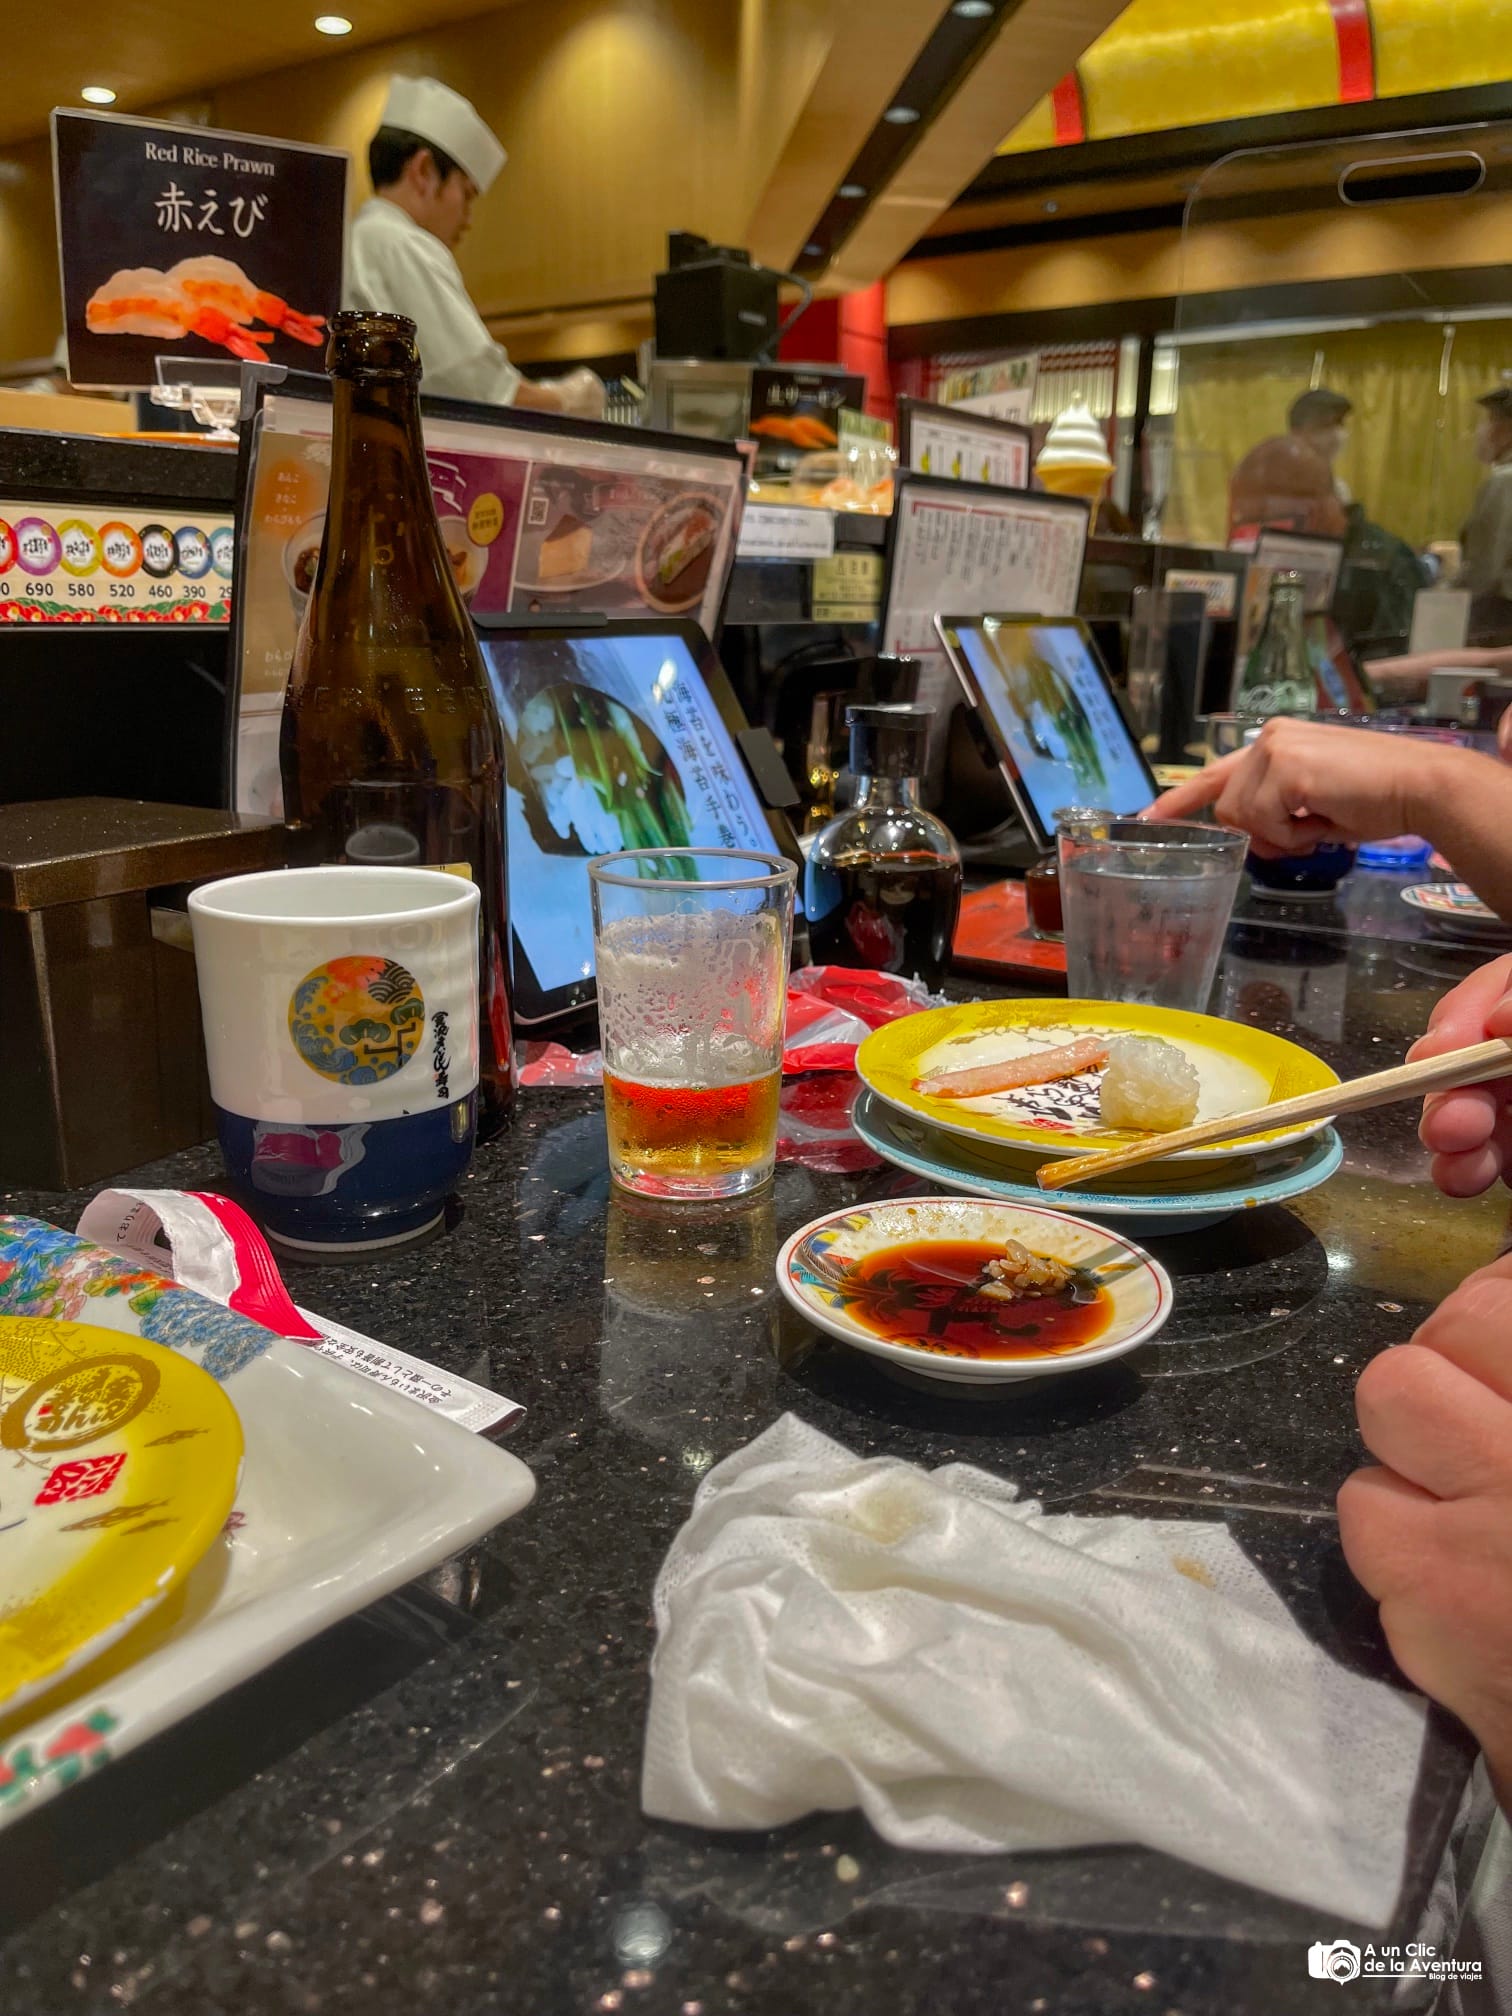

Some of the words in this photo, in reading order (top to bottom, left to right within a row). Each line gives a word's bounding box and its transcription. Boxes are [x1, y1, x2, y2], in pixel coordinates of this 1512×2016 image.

[145, 142, 178, 163] Red
[182, 147, 219, 168] Rice
[223, 152, 275, 176] Prawn
[154, 181, 269, 238] 赤えび
[25, 582, 54, 597] 690
[68, 583, 95, 597] 580
[109, 584, 135, 598] 520
[149, 585, 173, 598] 460
[183, 585, 206, 598] 390
